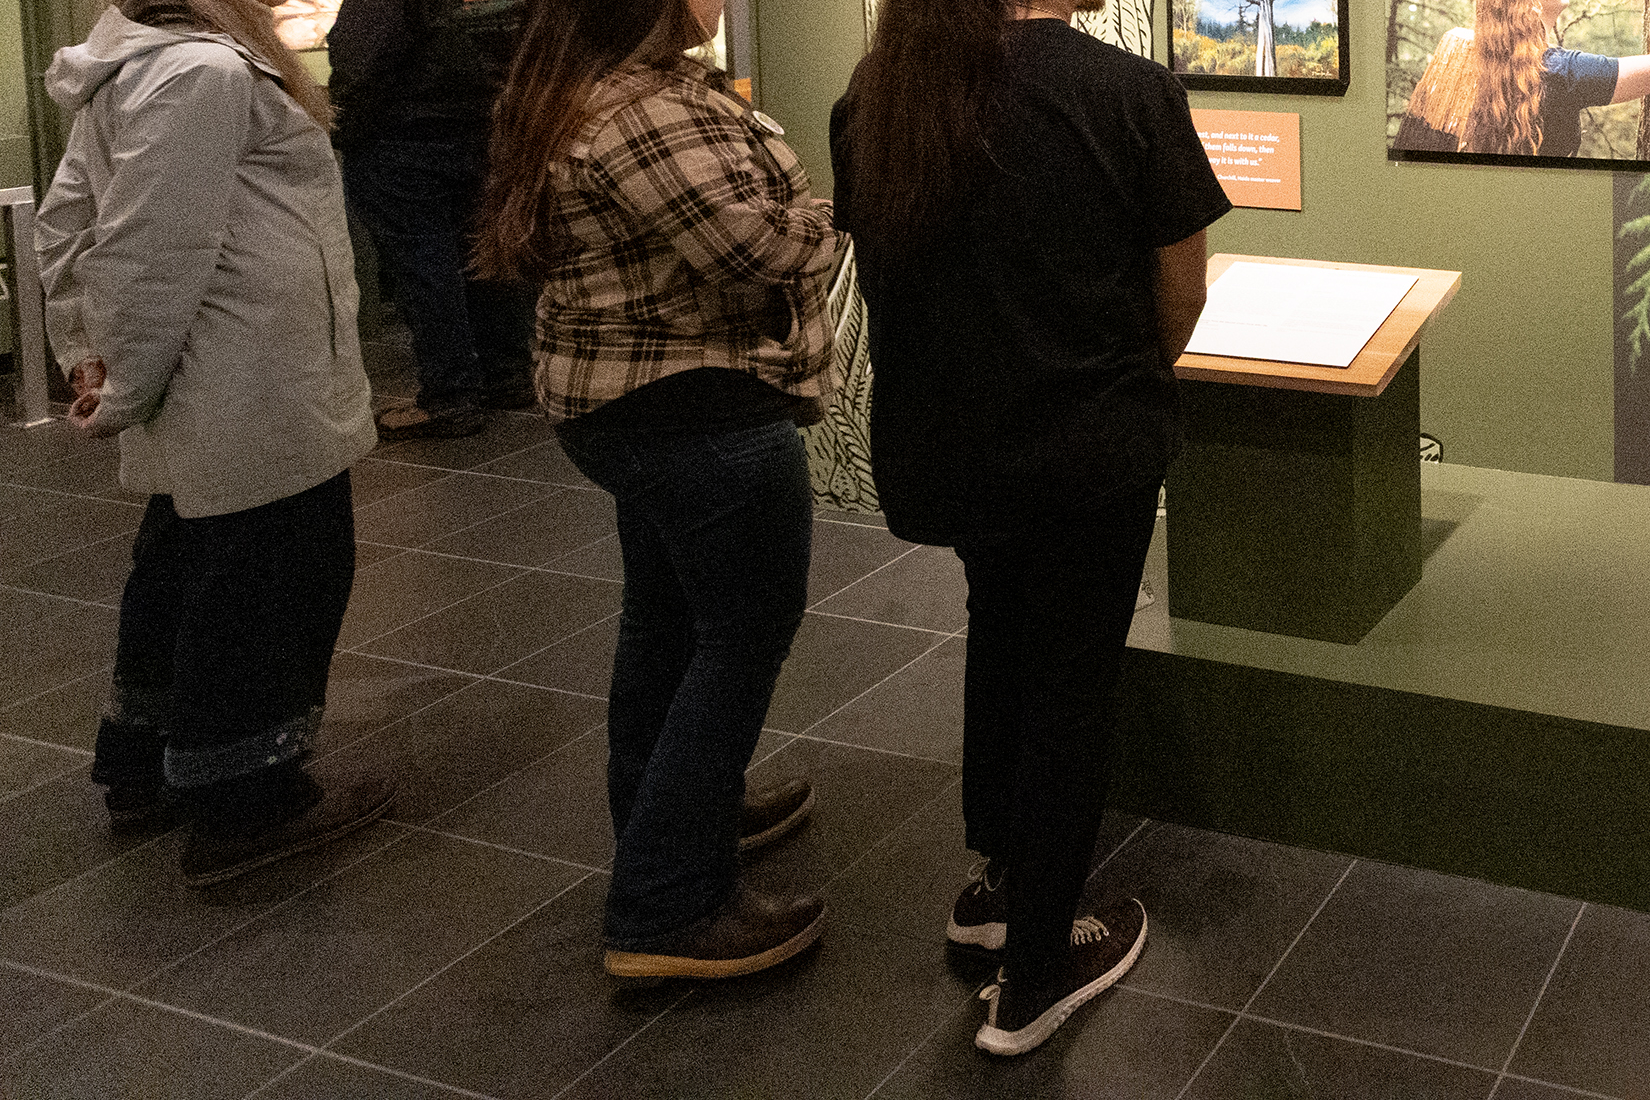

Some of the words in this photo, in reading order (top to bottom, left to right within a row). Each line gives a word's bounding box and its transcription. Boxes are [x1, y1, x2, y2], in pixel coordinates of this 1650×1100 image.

[1210, 131, 1224, 139] and
[1224, 132, 1239, 140] next
[1240, 132, 1247, 140] to
[1248, 132, 1254, 141] it
[1259, 133, 1280, 143] cedar,
[1222, 142, 1237, 153] falls
[1237, 144, 1258, 154] down,
[1258, 145, 1274, 154] then
[1221, 156, 1227, 164] it
[1227, 157, 1233, 165] is
[1233, 157, 1249, 165] with
